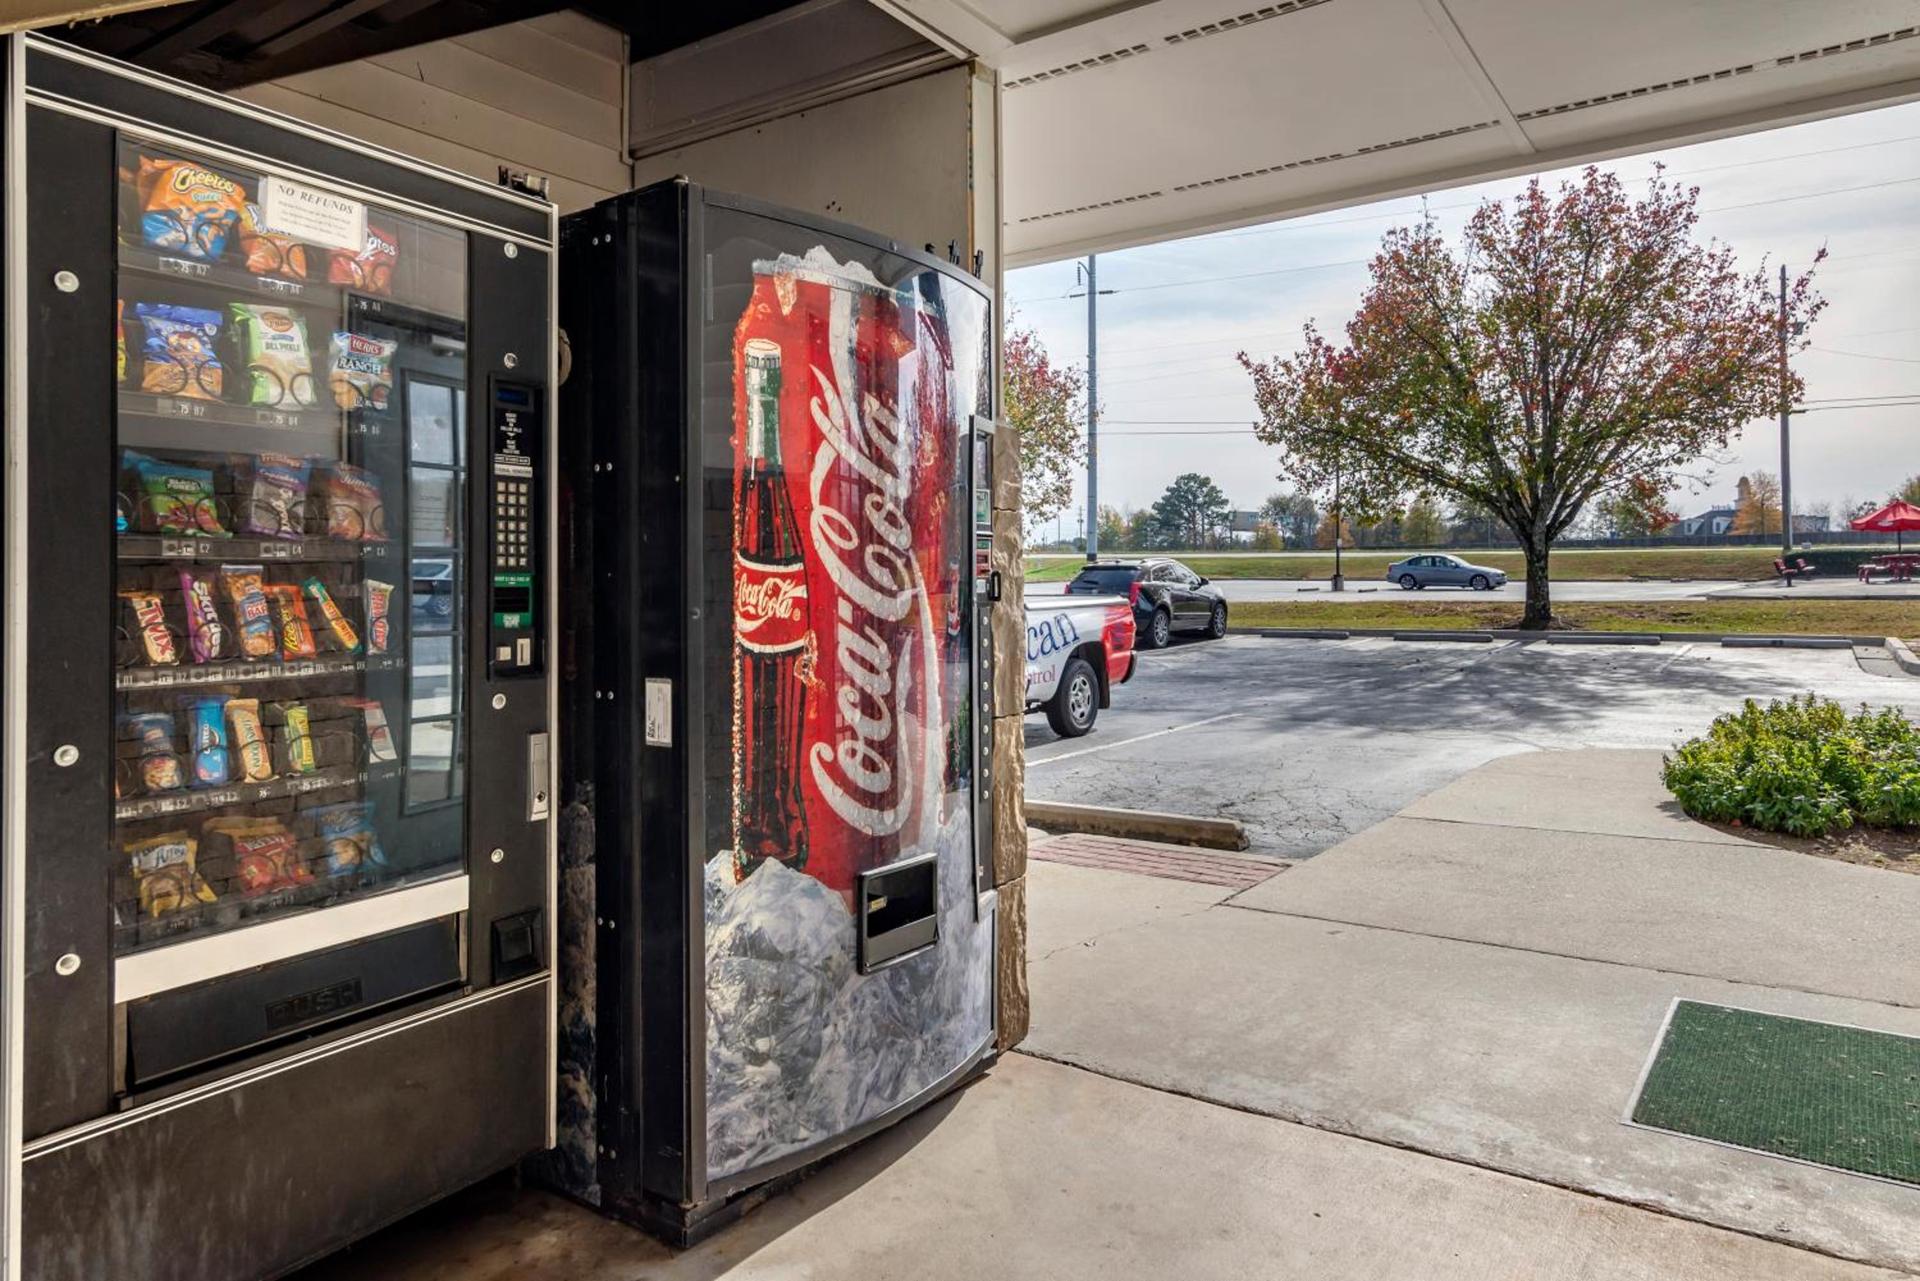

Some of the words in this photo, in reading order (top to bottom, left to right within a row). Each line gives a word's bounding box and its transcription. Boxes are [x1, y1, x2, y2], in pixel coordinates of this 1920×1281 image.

[174, 167, 235, 194] Cheetos
[278, 184, 295, 197] NO
[300, 191, 353, 214] REFUNDS
[338, 357, 382, 375] RANCH
[739, 573, 794, 619] Coca-Cola
[809, 363, 913, 836] Coca-Cola
